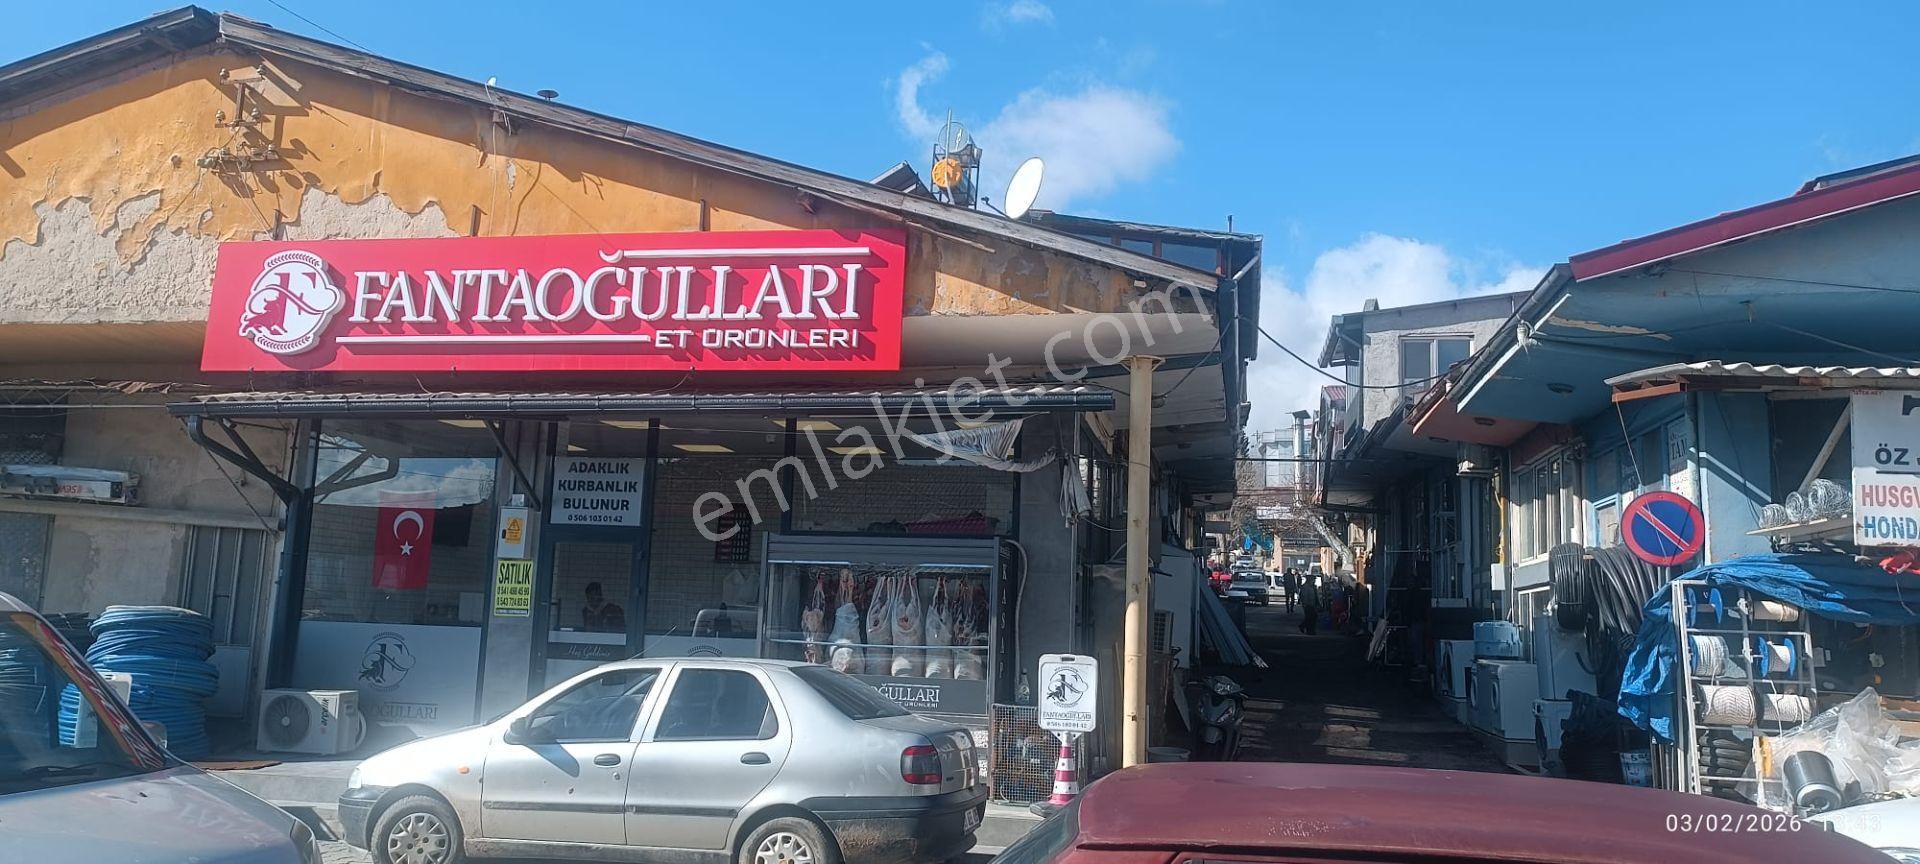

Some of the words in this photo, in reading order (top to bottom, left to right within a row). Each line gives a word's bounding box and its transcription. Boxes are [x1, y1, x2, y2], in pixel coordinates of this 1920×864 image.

[349, 249, 863, 324] FANTAOĞULLARI
[655, 329, 694, 348] ET
[1874, 443, 1910, 466] ÖZ
[568, 462, 629, 474] ADAKLIK
[558, 480, 637, 492] KURBANLIK
[563, 498, 630, 510] BULUNUR
[1863, 516, 1920, 539] HOND
[498, 563, 532, 584] SATILIK
